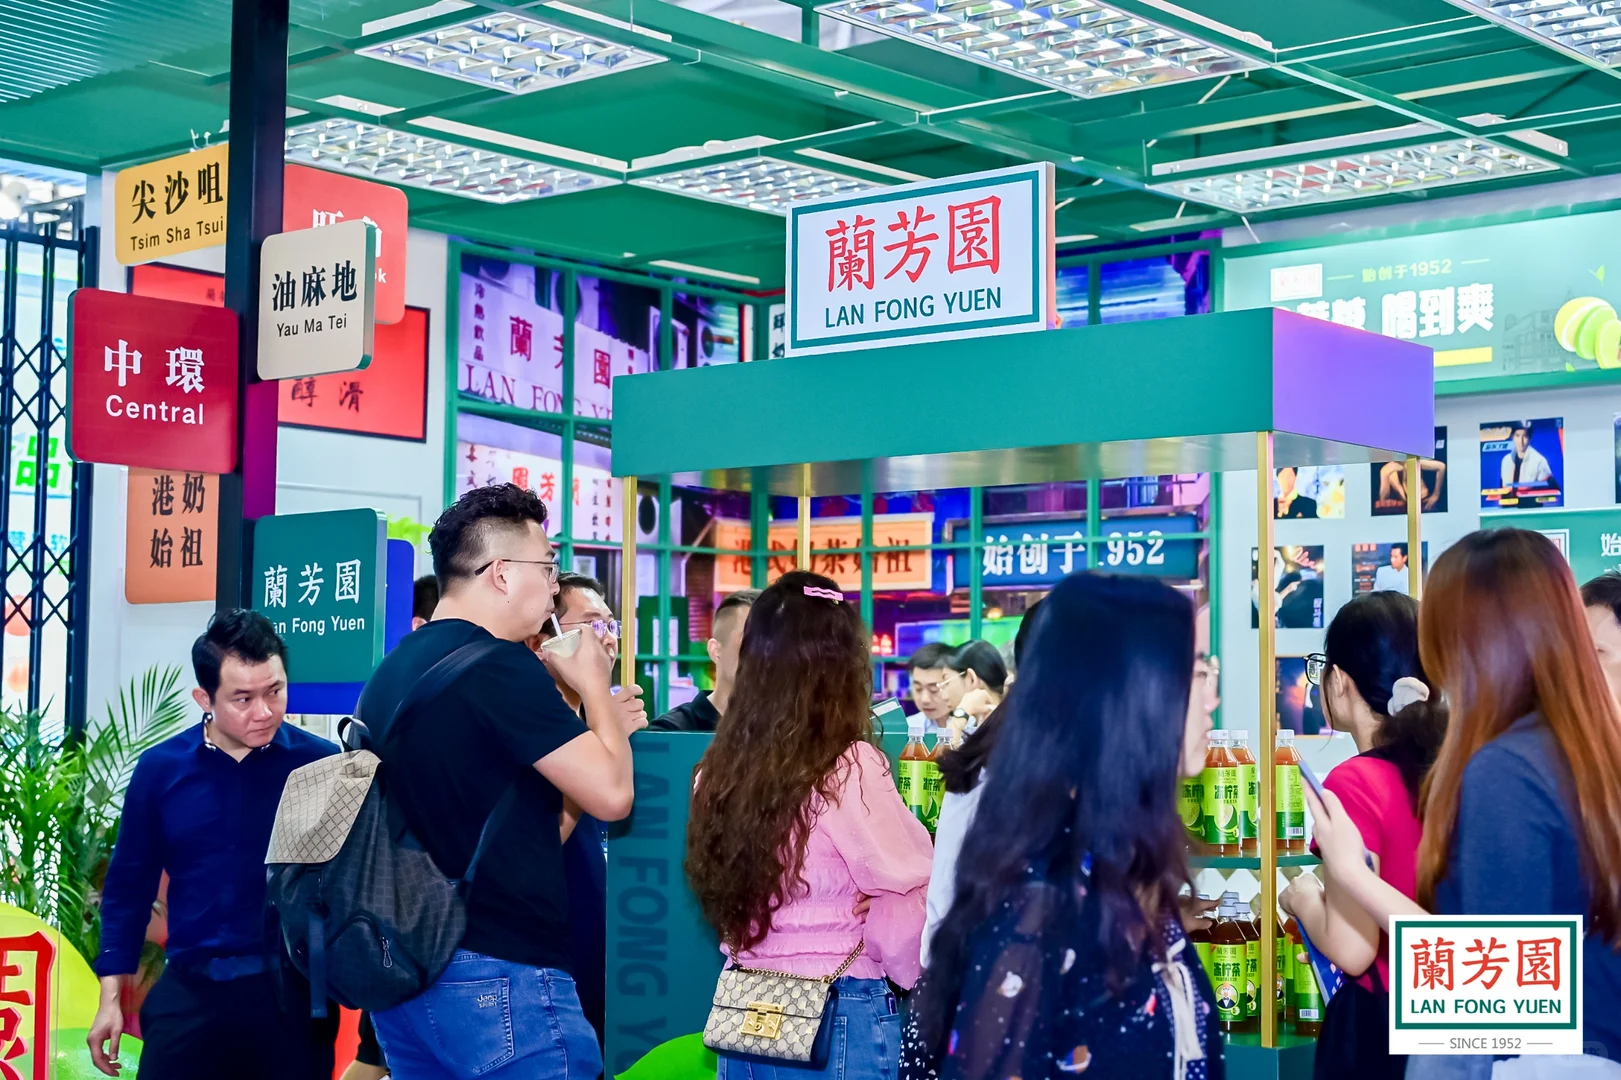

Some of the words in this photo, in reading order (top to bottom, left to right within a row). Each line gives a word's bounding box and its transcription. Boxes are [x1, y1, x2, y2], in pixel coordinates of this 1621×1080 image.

[131, 161, 224, 225] 尖沙咀
[130, 232, 160, 252] Tsim
[166, 227, 191, 244] Sha
[196, 218, 224, 239] Tsui
[825, 195, 1001, 292] 蘭芳園
[271, 259, 358, 312] 油麻地
[825, 303, 864, 329] LAN
[874, 294, 934, 323] FONG
[943, 286, 1001, 314] YUEN
[277, 321, 299, 338] Yau
[304, 318, 323, 334] Ma
[328, 313, 347, 329] Tei
[104, 339, 206, 395] 中環
[105, 395, 205, 426] Central
[982, 529, 1165, 577] 始创于952
[264, 558, 362, 609] 蘭芳園
[292, 617, 326, 637] Fong
[330, 614, 365, 632] Yuen
[616, 855, 669, 999] FONG
